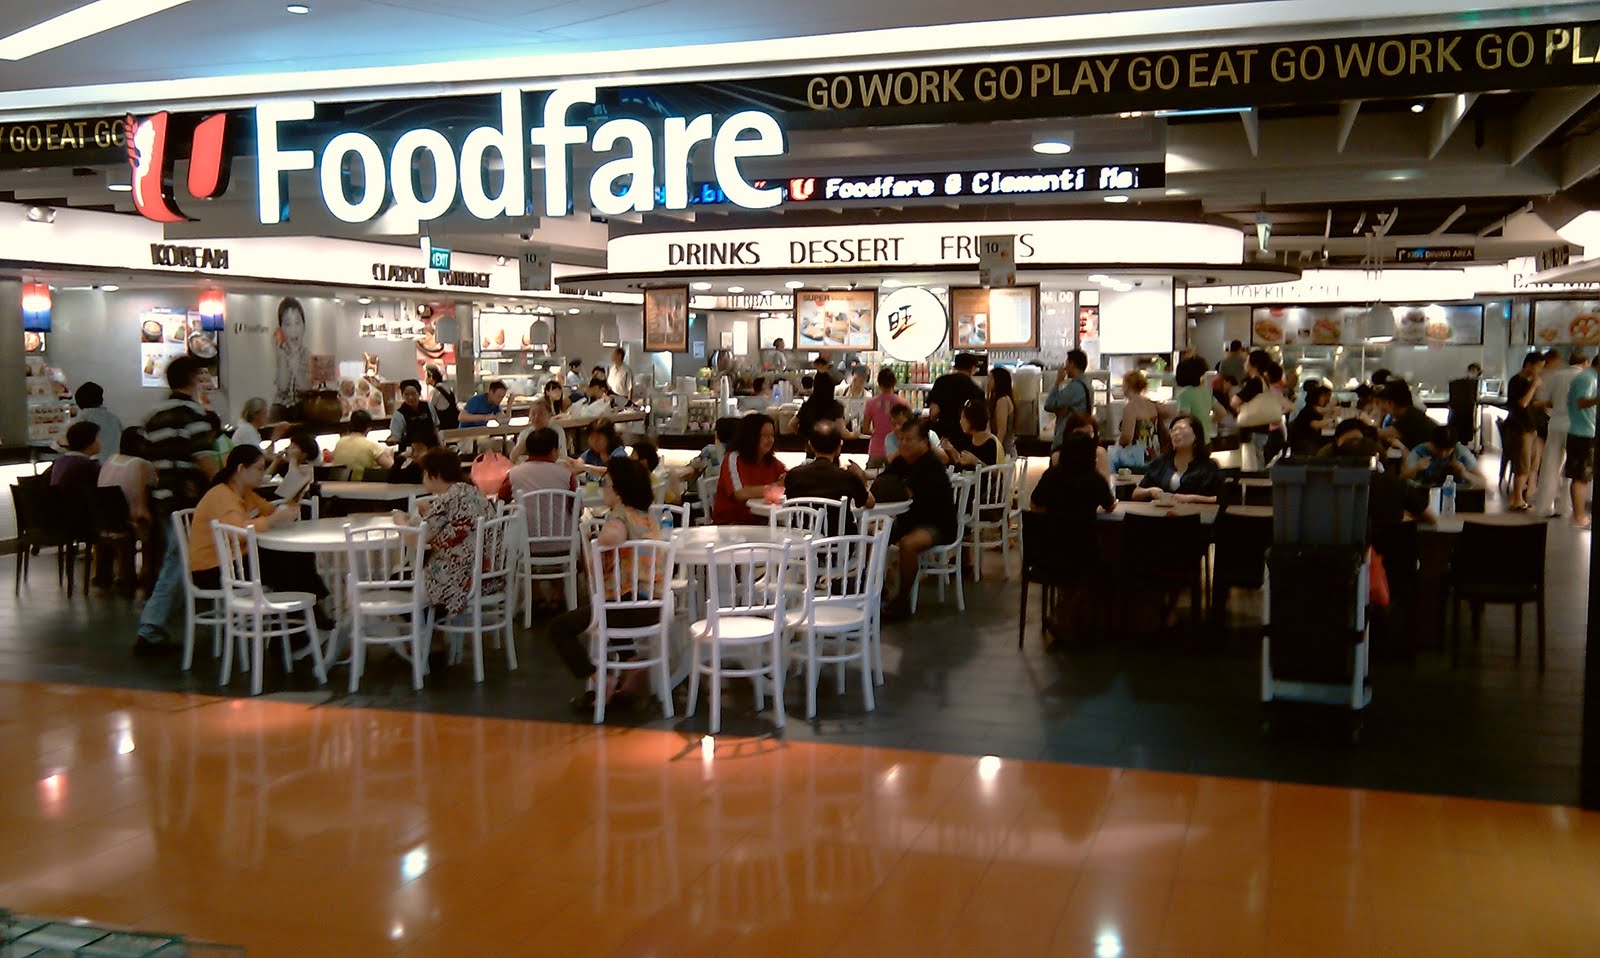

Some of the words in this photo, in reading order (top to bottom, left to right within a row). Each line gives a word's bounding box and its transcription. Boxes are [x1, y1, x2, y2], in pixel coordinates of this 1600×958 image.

[807, 75, 852, 110] GO
[859, 69, 963, 107] WORK
[974, 66, 1023, 101] GO
[1031, 59, 1119, 98] PLAY
[1128, 55, 1180, 92] GO
[1189, 49, 1258, 88] EAT
[1271, 45, 1325, 83] GO
[1335, 36, 1463, 79] WORK
[1476, 31, 1535, 70] GO
[10, 125, 42, 152] GO
[47, 122, 88, 151] EAT
[94, 118, 126, 148] GO
[253, 86, 786, 225] Foodfare
[825, 176, 935, 199] Foodfare
[972, 167, 1086, 194] Clementi
[150, 243, 229, 269] KOREAN
[435, 252, 449, 268] EXIT
[524, 253, 537, 264] 10
[668, 241, 761, 266] DRINKS
[790, 238, 905, 264] DESSERT
[985, 241, 999, 254] 10
[1453, 249, 1473, 258] AREA
